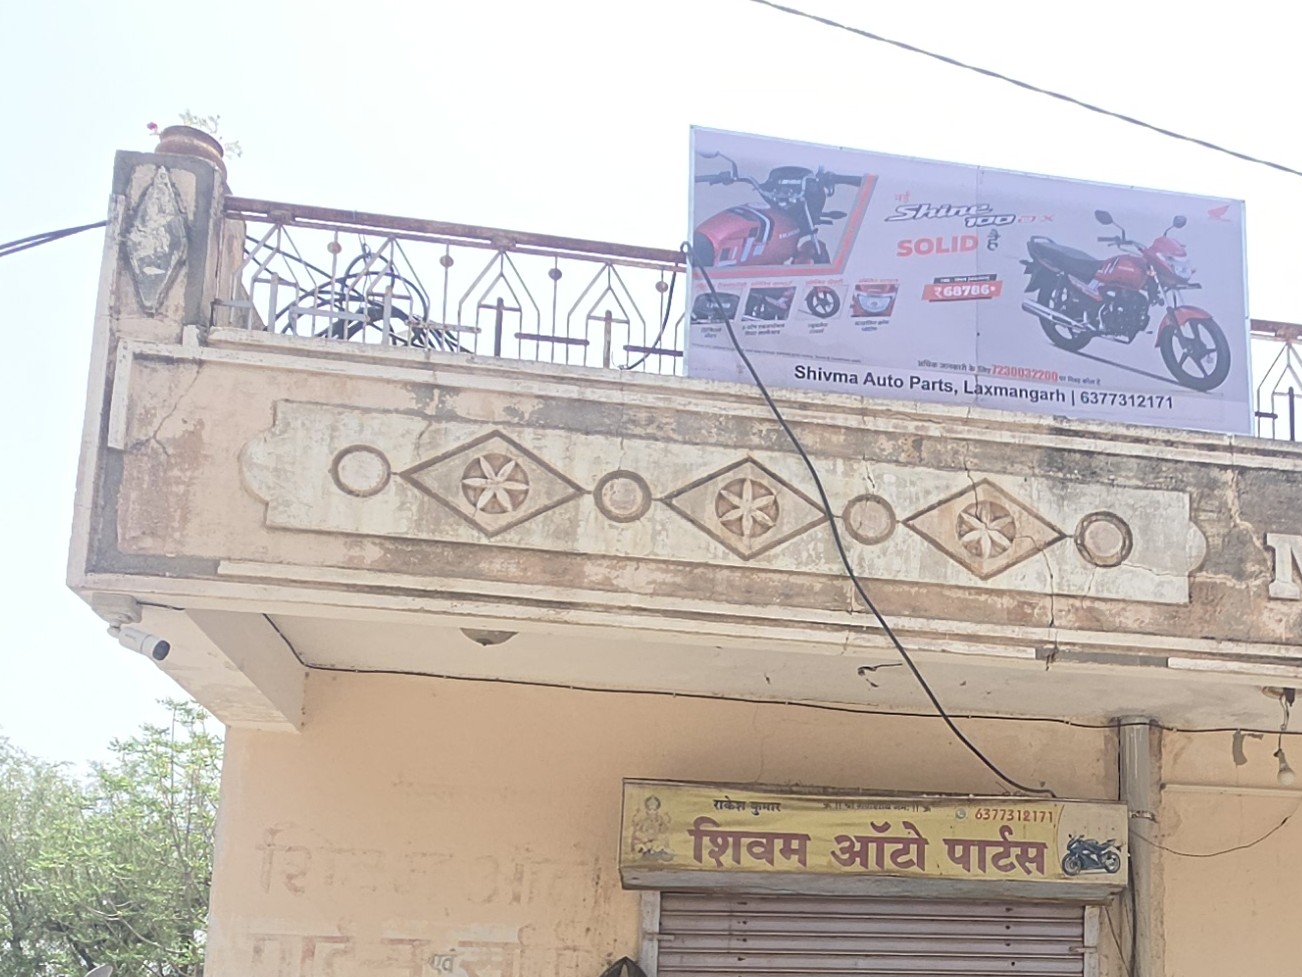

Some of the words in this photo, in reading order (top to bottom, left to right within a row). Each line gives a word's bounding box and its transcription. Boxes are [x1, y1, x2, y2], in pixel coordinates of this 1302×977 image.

[884, 204, 993, 222] Shine
[965, 214, 1016, 228] 100
[896, 235, 979, 257] SOLID
[794, 364, 859, 385] Shivma
[863, 372, 904, 389] Auto
[910, 376, 959, 396] Parts,
[964, 380, 1066, 403] Laxmangarh
[1080, 391, 1173, 409] 6377312171
[713, 796, 746, 812] राकेश
[751, 800, 782, 815] कुमार
[975, 808, 1053, 823] 6377312171
[687, 815, 811, 868] शिवम
[830, 820, 930, 872] ऑटो
[942, 824, 1048, 876] पार्टस
